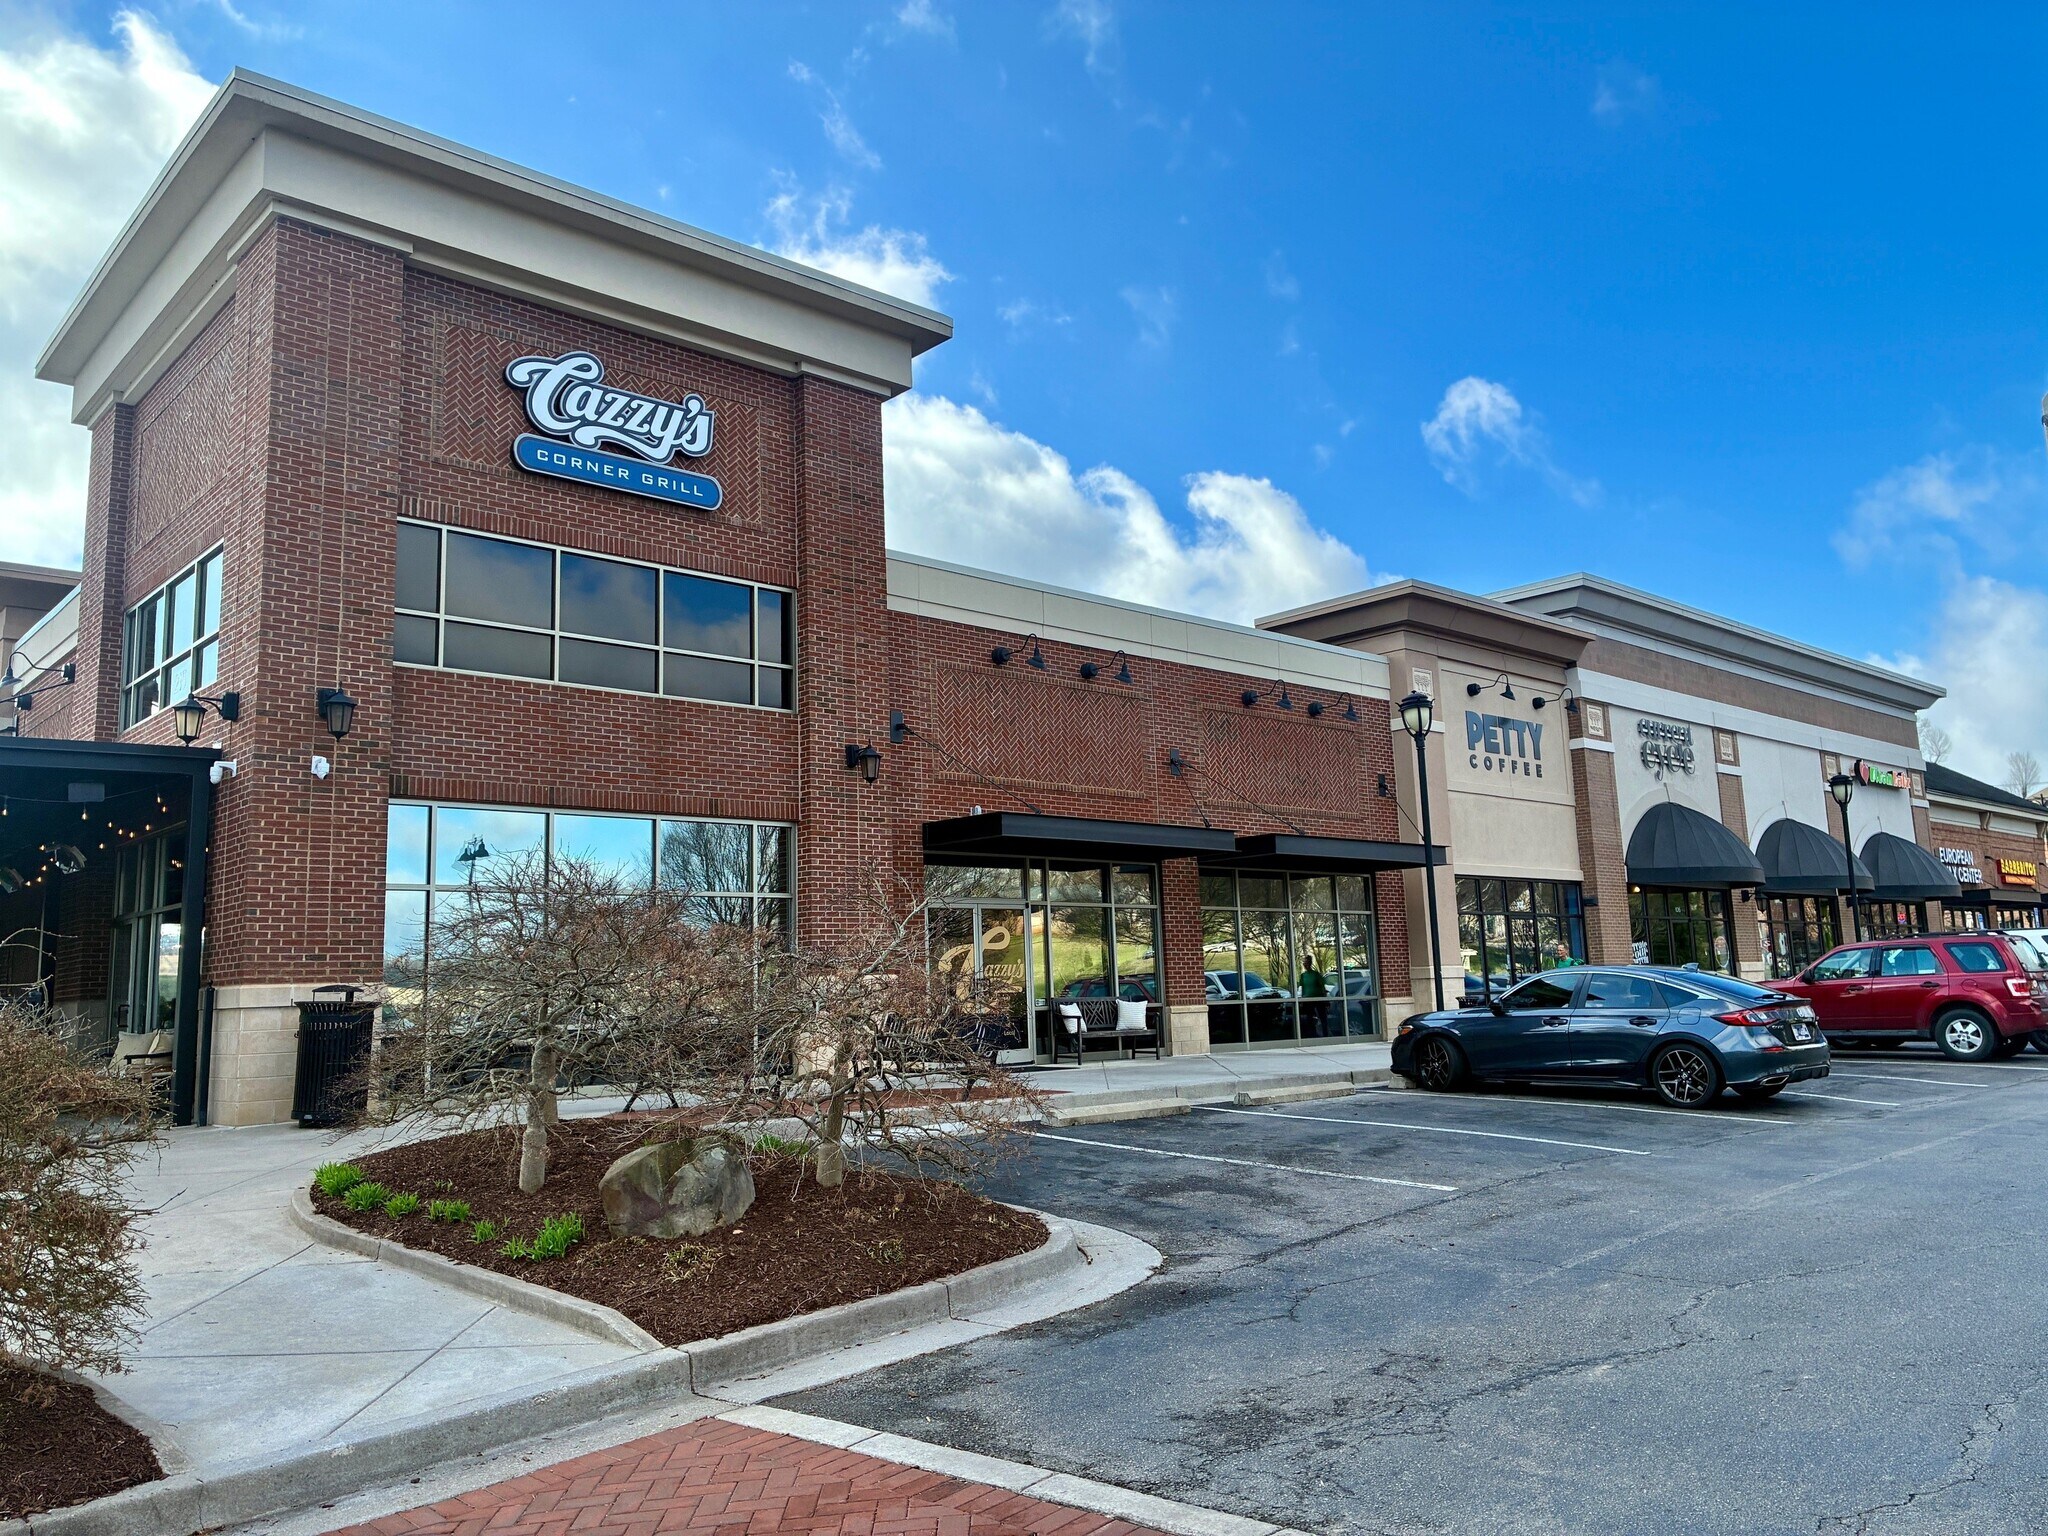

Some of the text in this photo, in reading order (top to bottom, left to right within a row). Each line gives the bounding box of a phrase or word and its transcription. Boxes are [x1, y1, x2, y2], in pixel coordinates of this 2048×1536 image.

[506, 353, 713, 463] Cazzy's
[536, 448, 704, 498] CORNER GRILL
[1465, 710, 1543, 761] PETTY
[1469, 753, 1543, 779] COFFEE
[1640, 740, 1696, 782] cycle
[1939, 846, 1975, 866] EUROPEAN
[1958, 866, 1984, 884] CENTER
